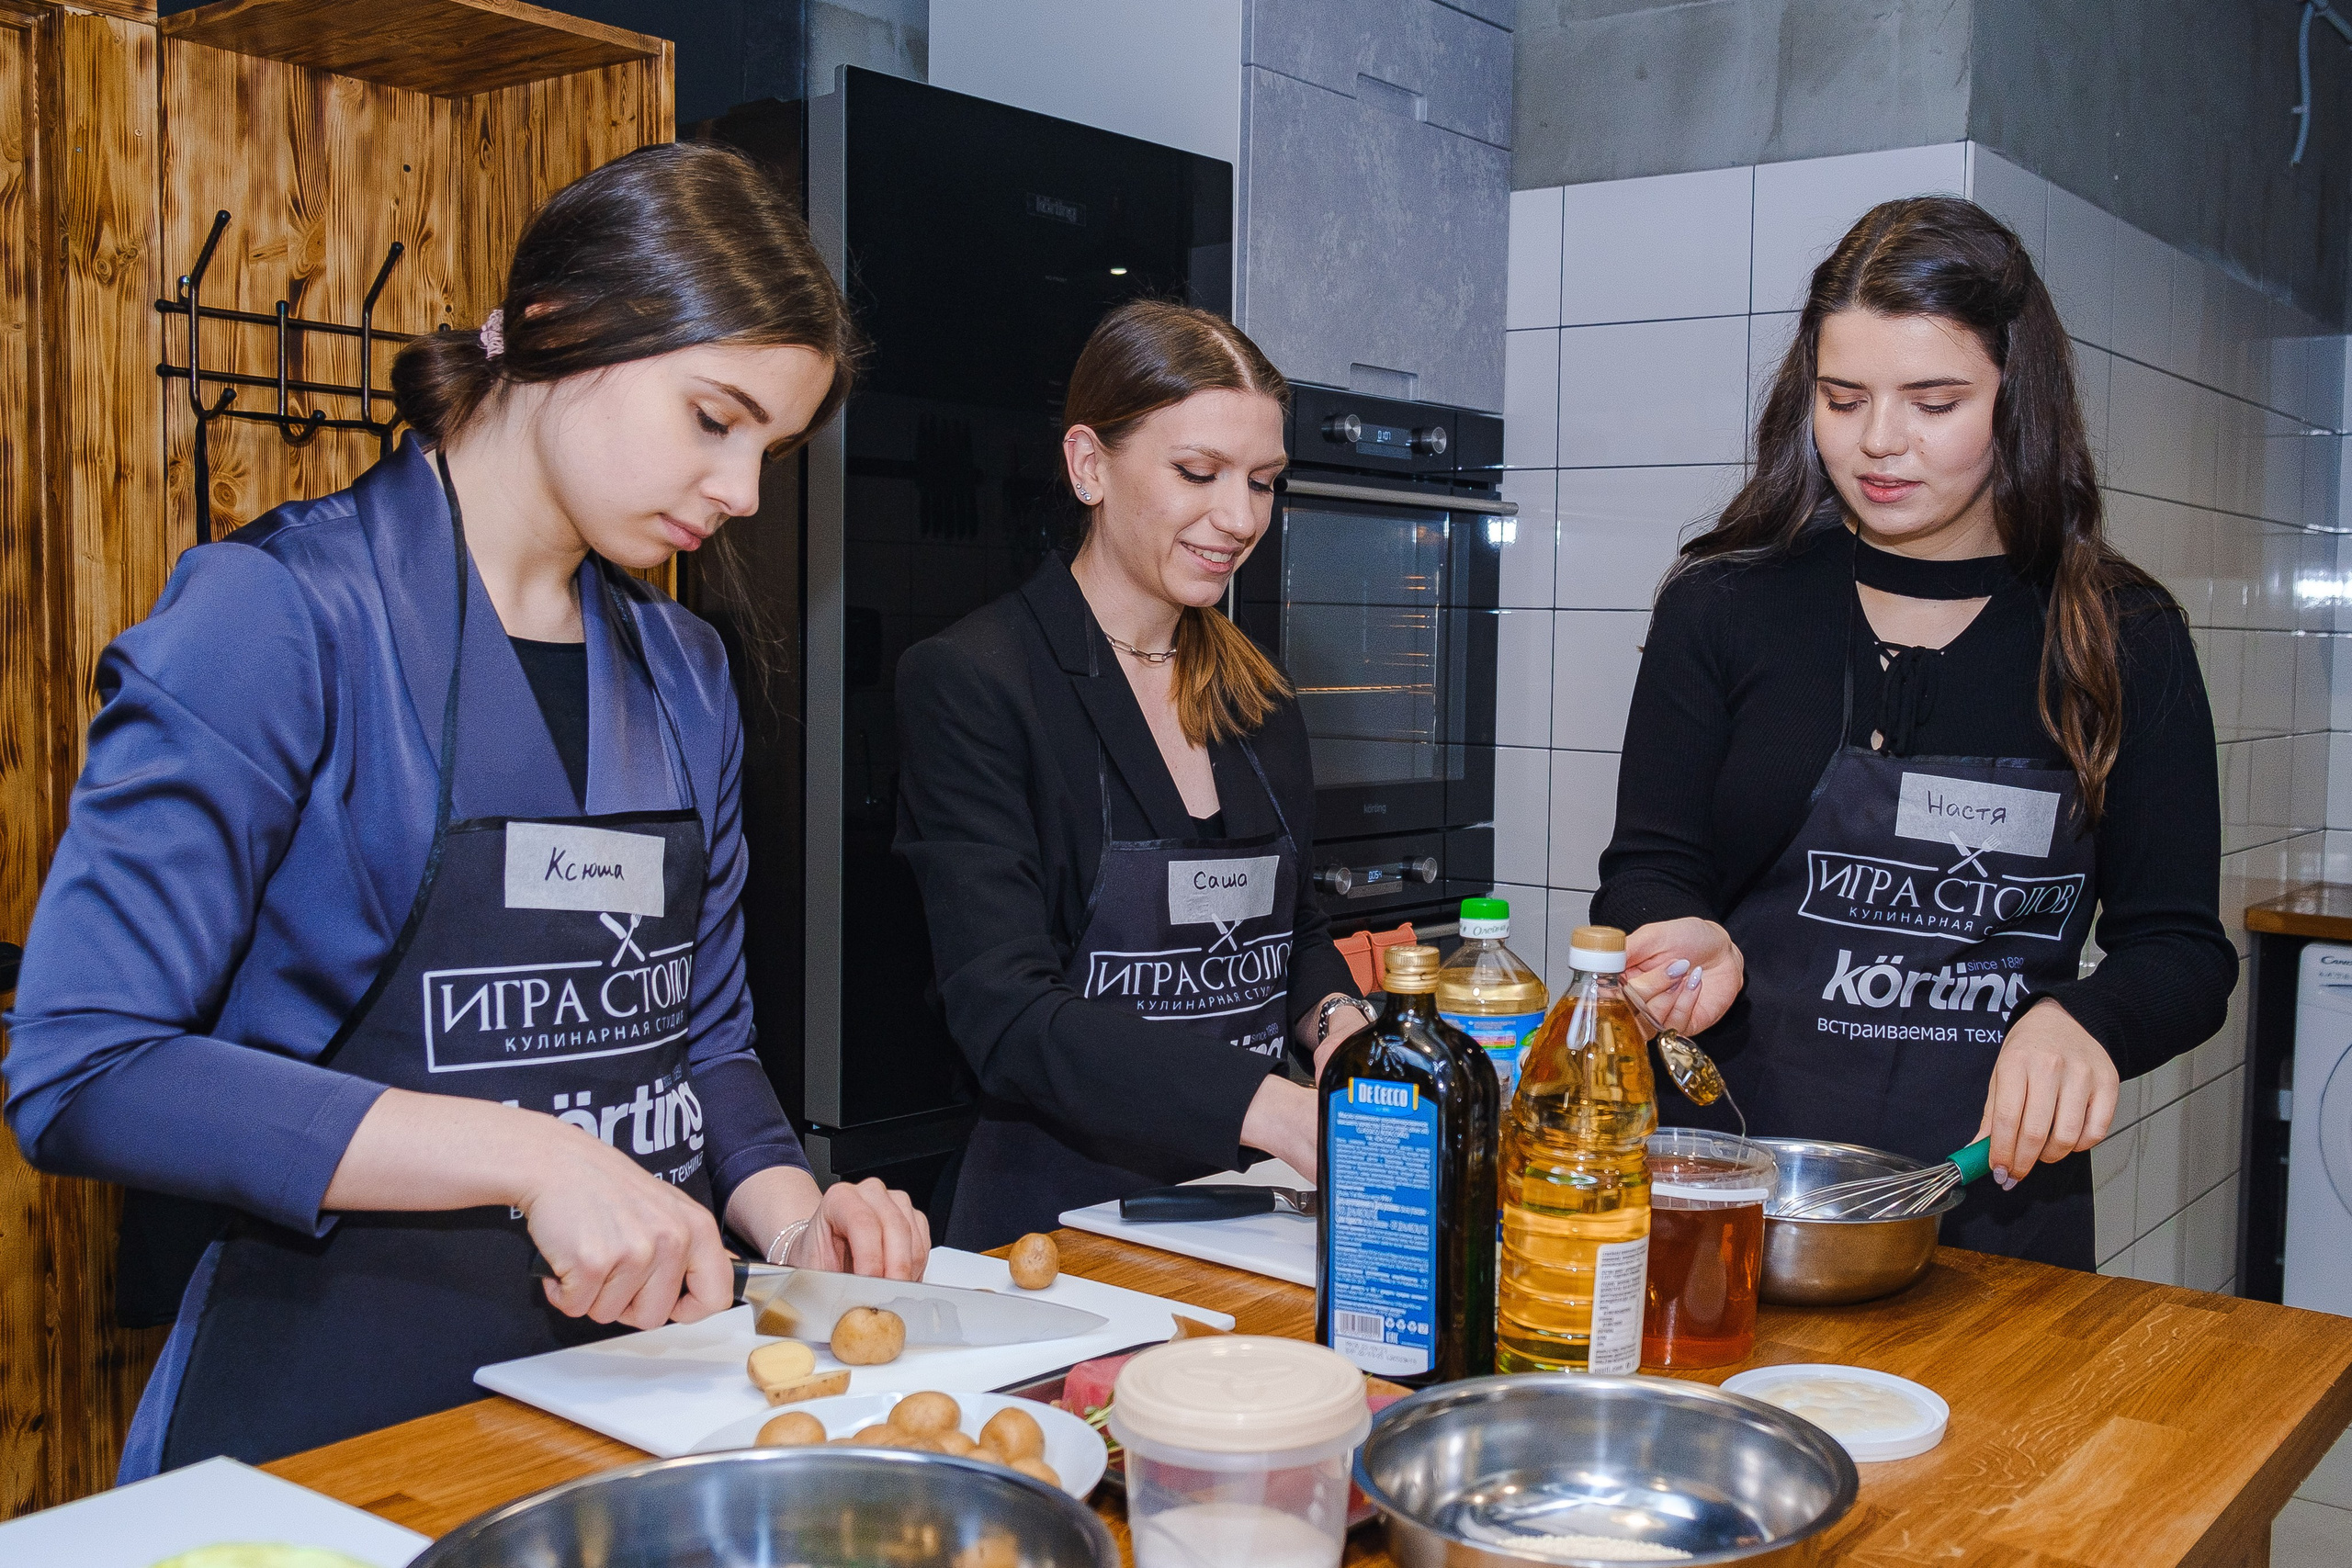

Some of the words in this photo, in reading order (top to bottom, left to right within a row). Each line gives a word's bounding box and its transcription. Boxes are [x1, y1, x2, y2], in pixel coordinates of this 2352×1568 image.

[1363, 803, 1386, 814] körting
[1926, 790, 2007, 826] Настя
[545, 847, 625, 881] Ксюша
[1193, 871, 1248, 890] Саша
[1819, 859, 1921, 908] ИГРА
[1849, 906, 1973, 932] КУЛИНАРНАЯ
[1097, 958, 1200, 998] ИГРА
[1200, 940, 1293, 990] СТОЛО
[1967, 958, 1997, 972] since
[440, 976, 589, 1034] ИГРА
[600, 954, 693, 1018] СТОЛО
[1136, 991, 1241, 1011] КУЛИНАРНАЯ
[1821, 949, 2030, 1023] körting
[504, 1021, 650, 1053] КУЛИНАРНАЯ
[1817, 1017, 1958, 1042] встраиваемая
[502, 1080, 706, 1156] örting
